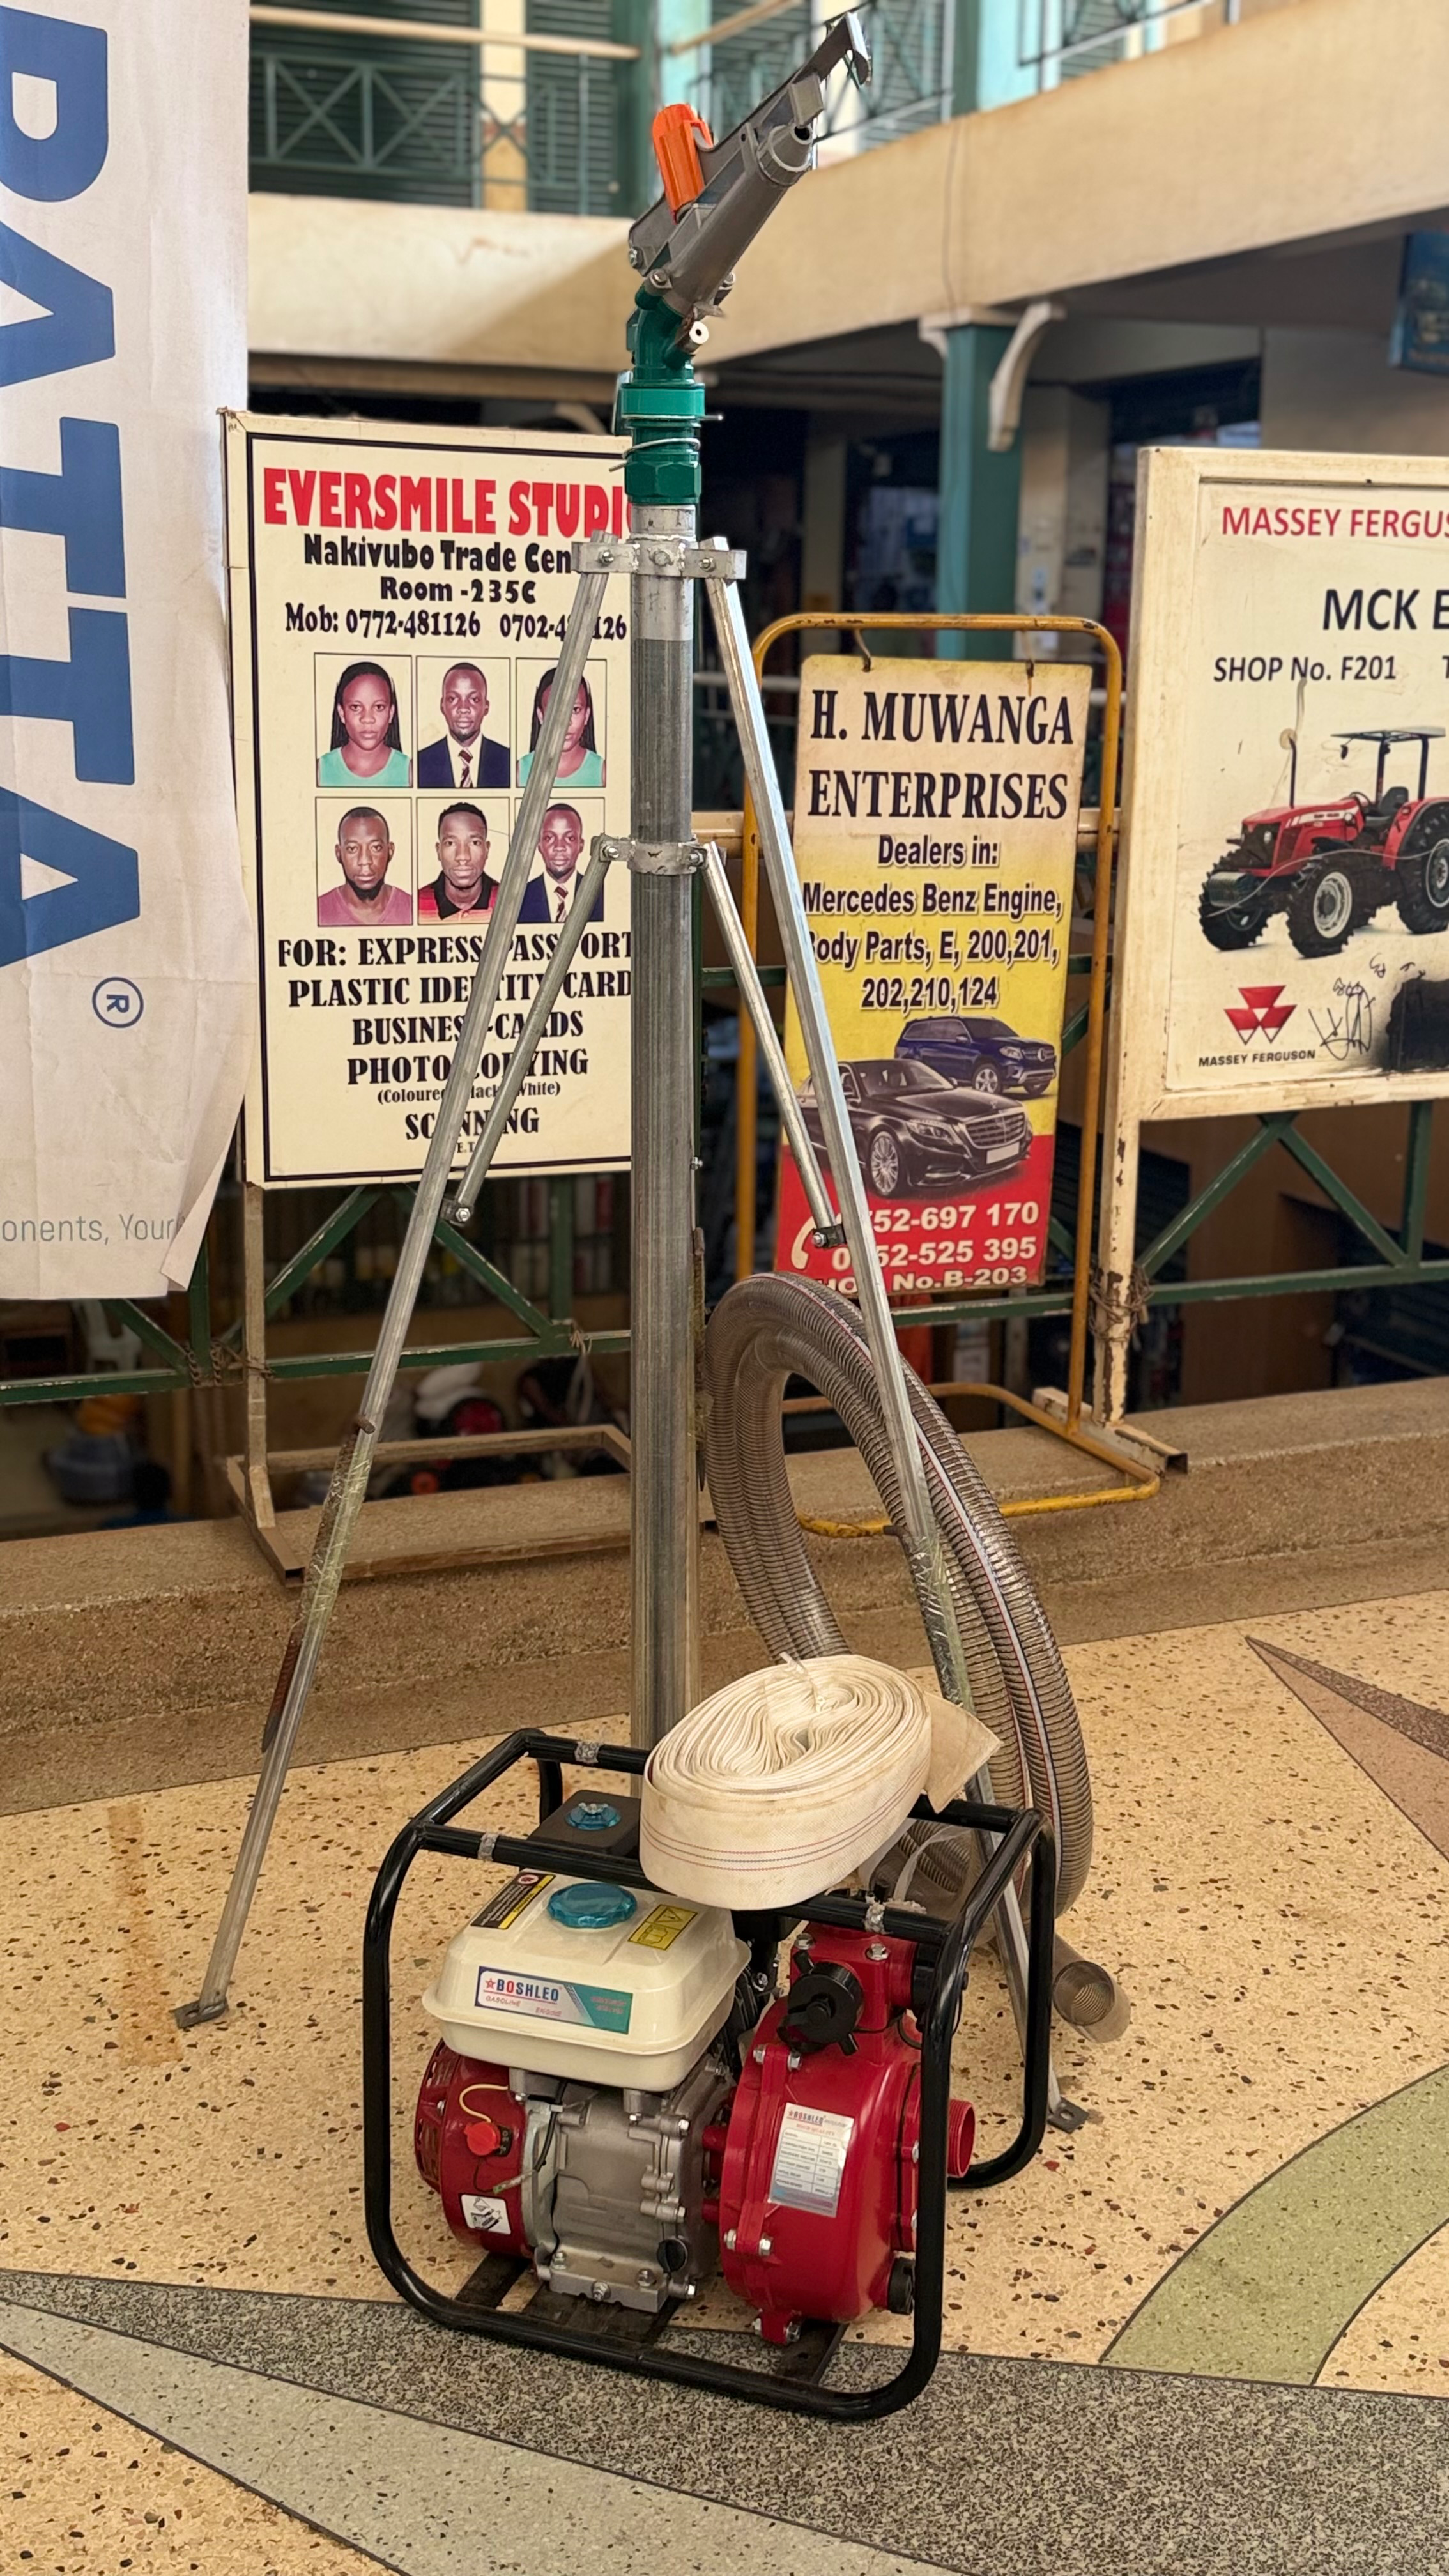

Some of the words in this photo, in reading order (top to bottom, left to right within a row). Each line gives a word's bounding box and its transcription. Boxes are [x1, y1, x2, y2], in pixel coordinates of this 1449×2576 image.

[264, 467, 496, 535] EVERSMILE
[508, 480, 631, 539] STUDI
[1222, 507, 1341, 535] MASSEY
[304, 533, 434, 570] Nakivubo
[441, 540, 516, 572] Trade
[525, 542, 572, 574] Cen
[380, 576, 452, 602] Room
[285, 602, 339, 632] Mob:
[346, 608, 480, 639] 0772-481126
[500, 613, 627, 641] 0702-4126
[1322, 588, 1420, 631] MCK
[1213, 657, 1282, 682] SHOP
[1291, 657, 1332, 682] No.
[1342, 656, 1397, 681] F201
[810, 689, 847, 740] H.
[862, 691, 1073, 745] MUWANGA
[808, 770, 1068, 820] ENTERPRISES
[878, 834, 964, 865] Dealers
[972, 836, 998, 864] in:
[803, 882, 914, 912] Mercedes
[923, 883, 976, 913] Benz
[983, 883, 1061, 920] Engine,
[278, 939, 346, 967] FOR:
[358, 936, 484, 966] EXPRESS
[509, 932, 631, 962] ASSORT
[865, 931, 931, 967] Parts,
[939, 930, 959, 965] E,
[967, 928, 1058, 965] 200,201,
[288, 977, 410, 1008] PLASTIC
[862, 976, 997, 1013] 202,210,124
[1198, 1053, 1248, 1068] MASSEY
[1252, 1049, 1315, 1064] FERGUSON
[405, 1107, 539, 1140] SCNNNG
[119, 1213, 174, 1241] Your
[836, 1205, 976, 1233] 52-697
[986, 1202, 1039, 1227] 170
[832, 1240, 974, 1271] 052-525
[983, 1236, 1036, 1261] 395
[496, 1979, 559, 2002] BOSHLEO
